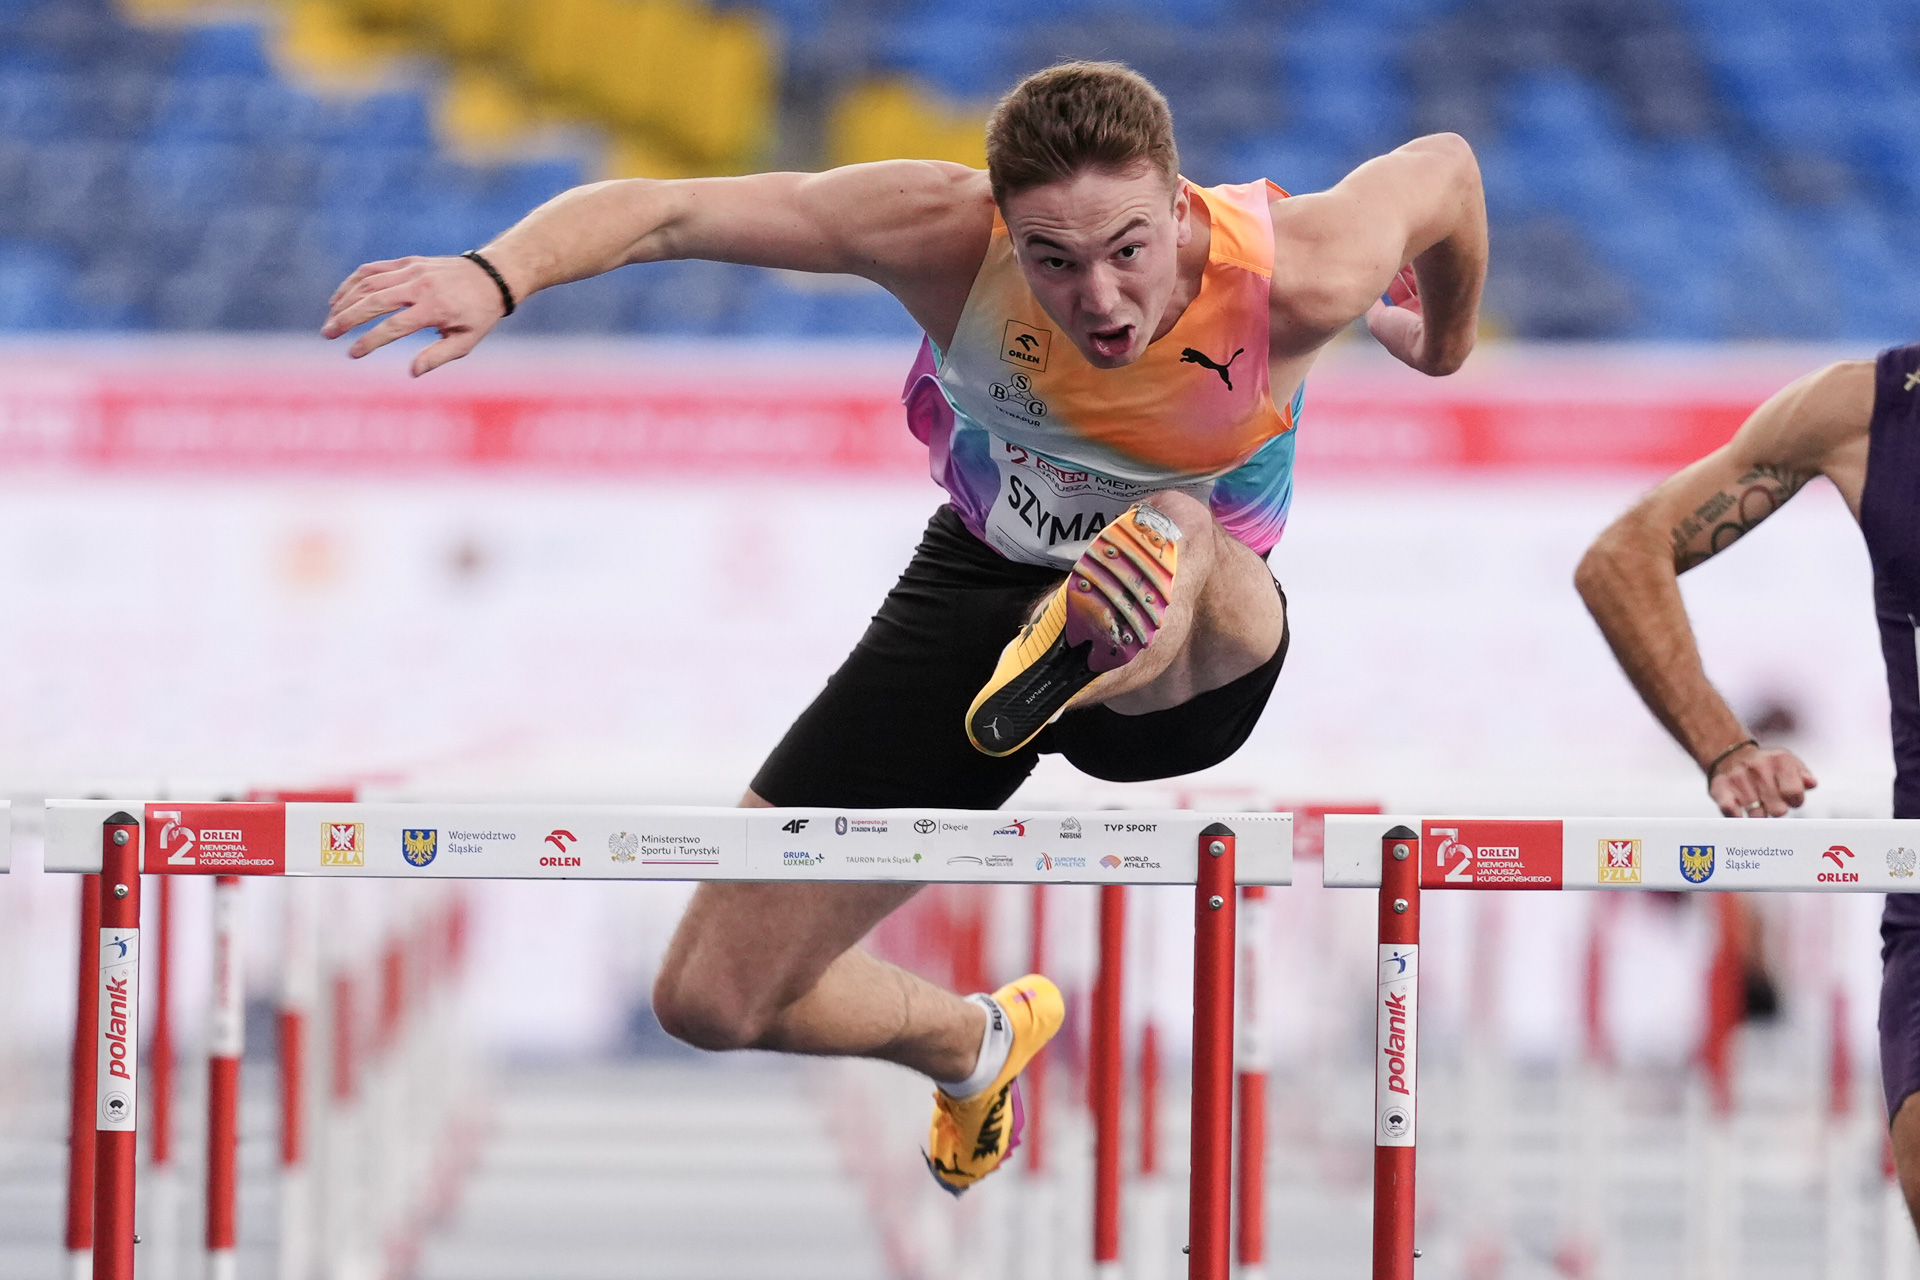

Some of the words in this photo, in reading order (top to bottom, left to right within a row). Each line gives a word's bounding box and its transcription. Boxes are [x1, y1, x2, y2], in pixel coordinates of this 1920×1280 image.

[1008, 350, 1040, 364] ORLEN
[1038, 460, 1086, 482] ORLEN
[1008, 475, 1121, 546] SZYMA
[782, 819, 810, 833] 4F
[942, 823, 969, 832] Okęcie
[1104, 824, 1123, 832] TVP
[1126, 824, 1158, 832] SPORT
[203, 832, 239, 840] ORLEN
[448, 831, 517, 842] Województwo
[641, 835, 701, 844] Ministerstwo
[448, 844, 483, 855] Śląskie
[641, 847, 671, 856] Sportu
[679, 847, 720, 857] Turystyki
[1480, 849, 1517, 857] ORLEN
[1725, 847, 1794, 858] Województwo
[200, 858, 275, 866] KUSOCIŃSKIEGO
[323, 852, 362, 865] PZLA
[539, 857, 581, 867] ORLEN
[783, 859, 815, 867] LUXMED
[892, 855, 911, 864] Śląski
[1725, 860, 1760, 871] Śląskie
[1477, 874, 1552, 882] KUSOCIŃSKIEGO
[1600, 869, 1639, 881] PZLA
[1817, 872, 1859, 882] ORLEN
[105, 975, 131, 1080] polanik
[1384, 991, 1410, 1095] polanik
